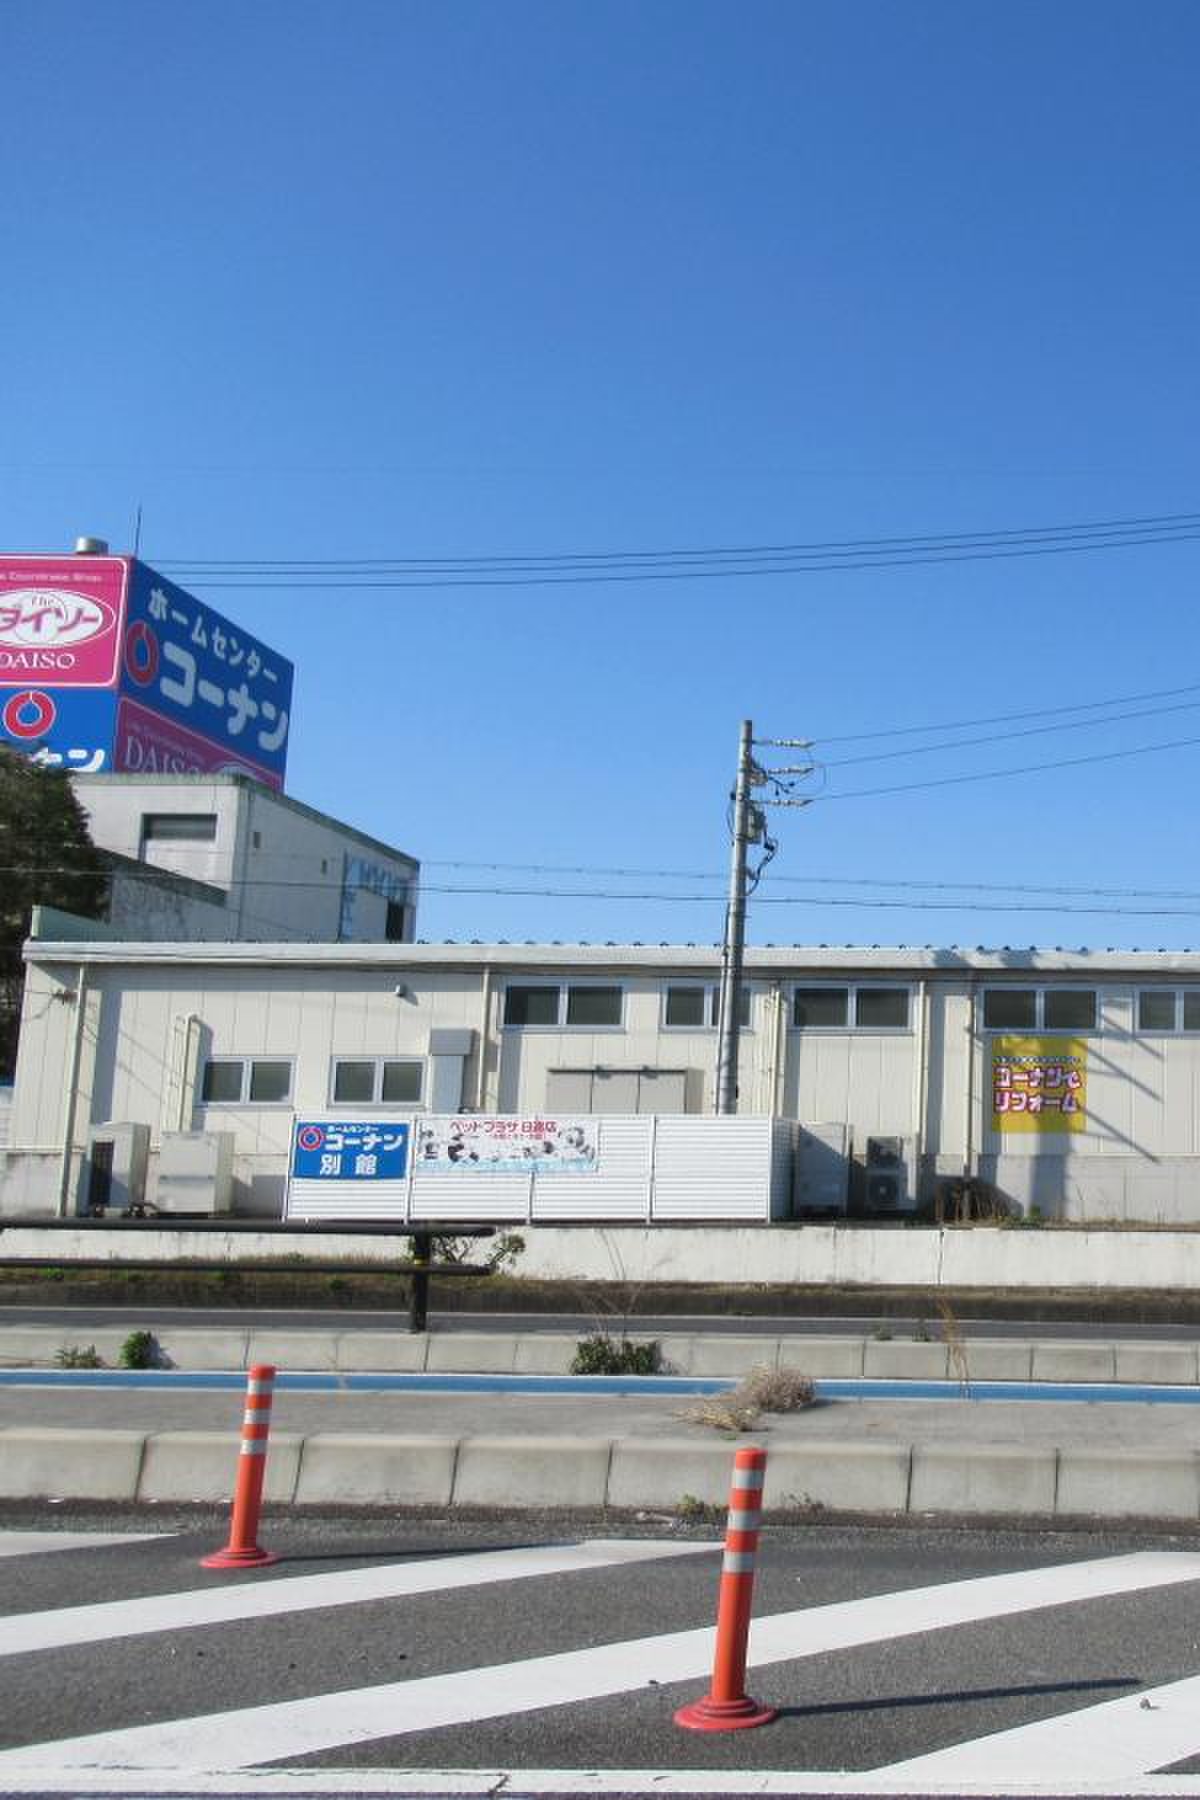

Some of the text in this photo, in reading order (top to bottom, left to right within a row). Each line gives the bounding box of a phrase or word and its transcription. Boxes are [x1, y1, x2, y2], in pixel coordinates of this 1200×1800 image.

[149, 588, 278, 682] ホームセンター
[160, 641, 288, 752] コーナン
[993, 1066, 1082, 1089] コーナンで
[994, 1090, 1080, 1114] リフォーム
[325, 1133, 403, 1151] コーナン
